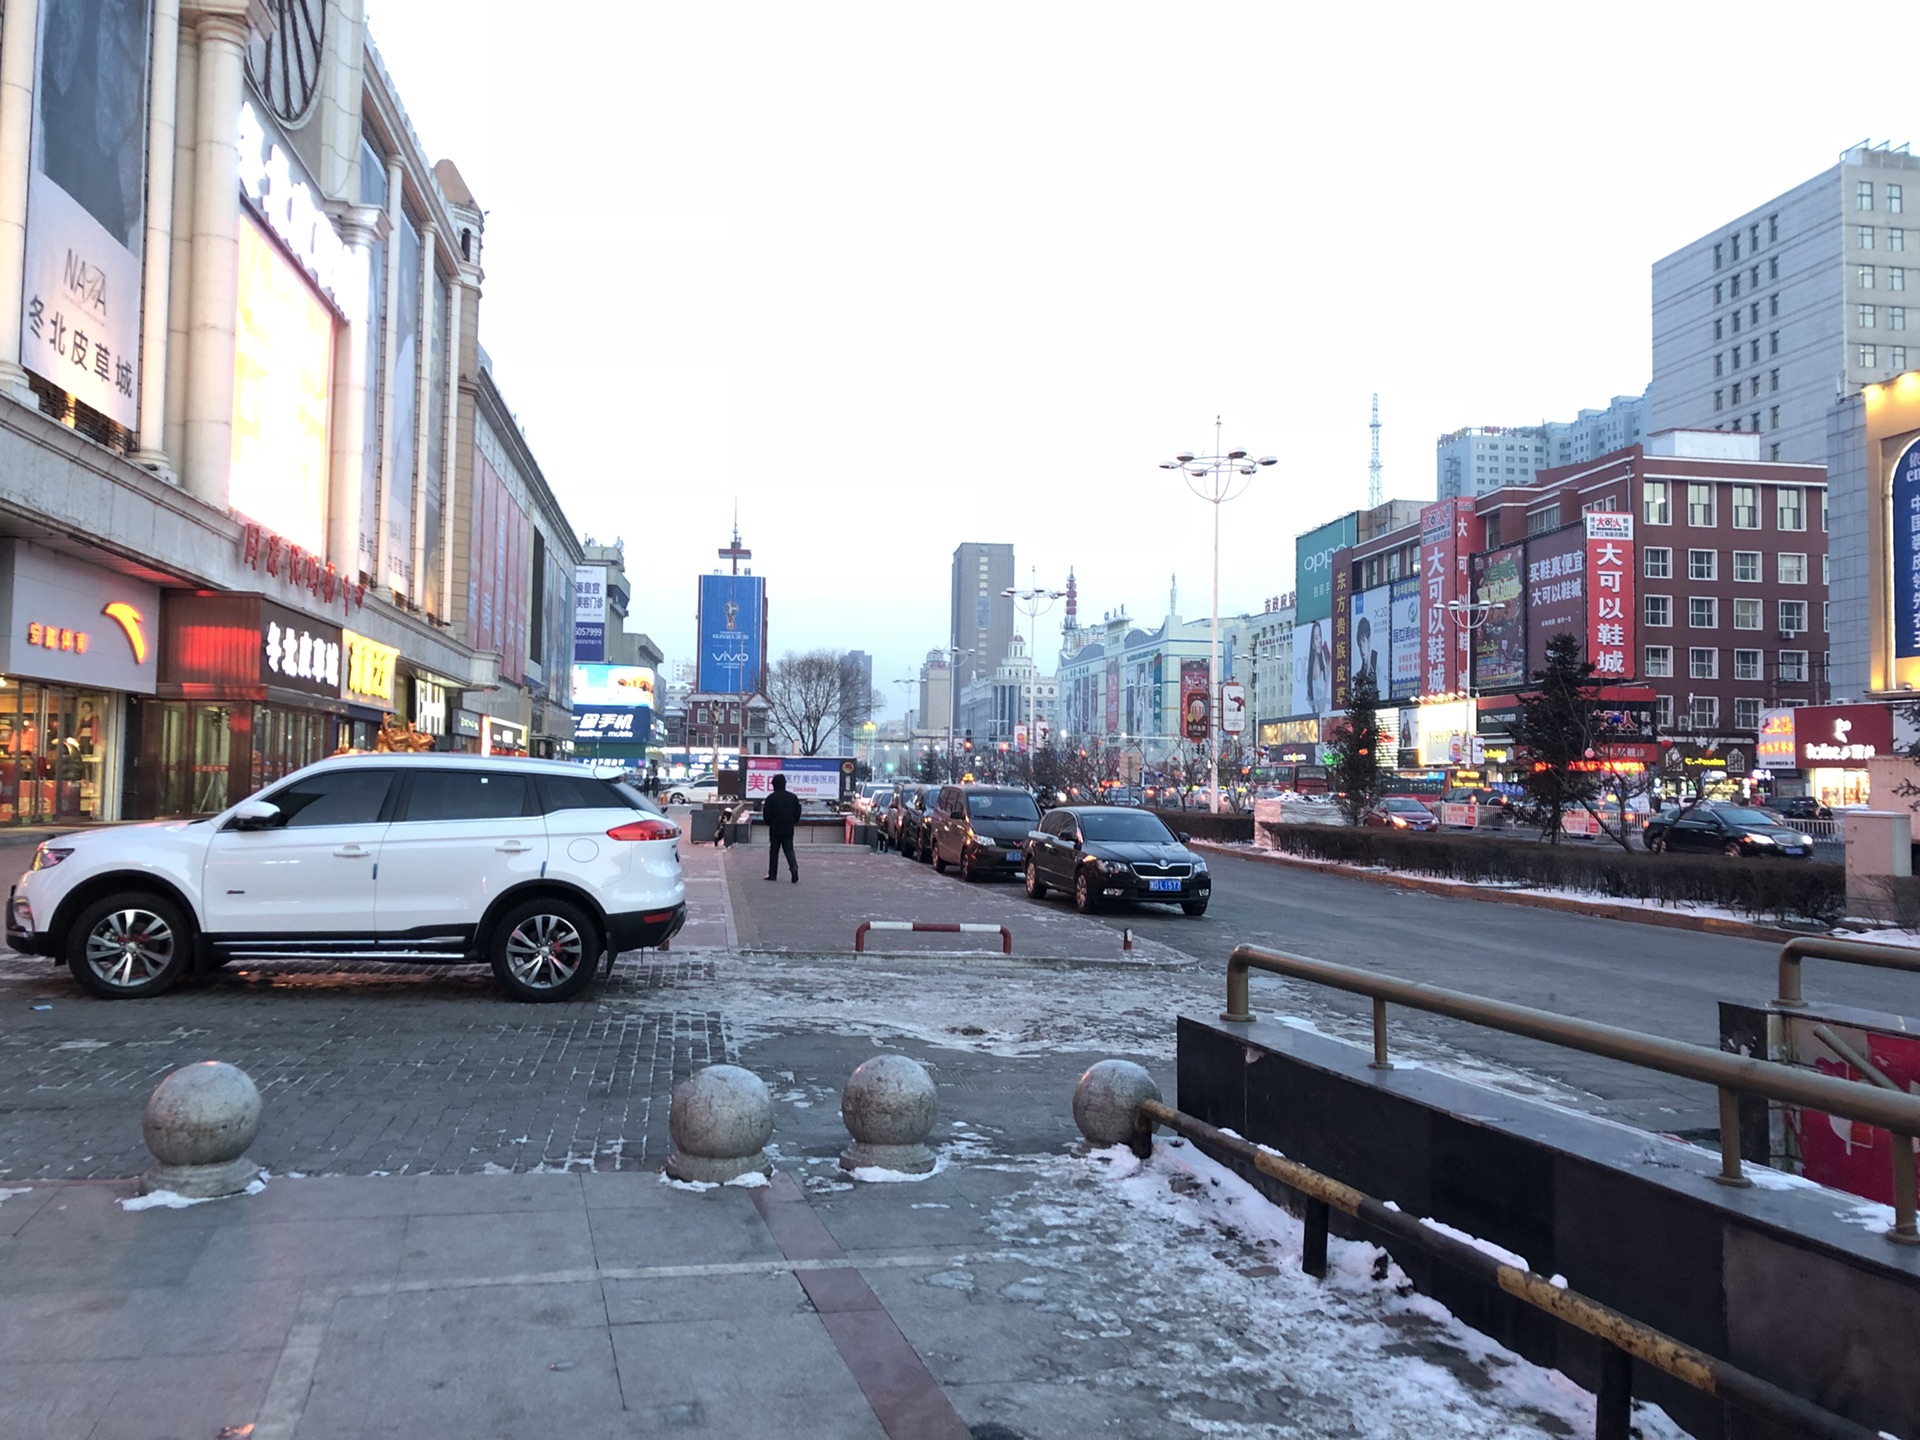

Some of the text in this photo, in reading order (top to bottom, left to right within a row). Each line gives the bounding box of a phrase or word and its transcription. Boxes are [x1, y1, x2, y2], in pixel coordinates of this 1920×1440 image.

[1529, 549, 1583, 583] 买鞋真便宜
[1532, 577, 1582, 607] 大可以鞋城
[1596, 542, 1625, 674] 大可以鞋城
[712, 651, 750, 662] vivo
